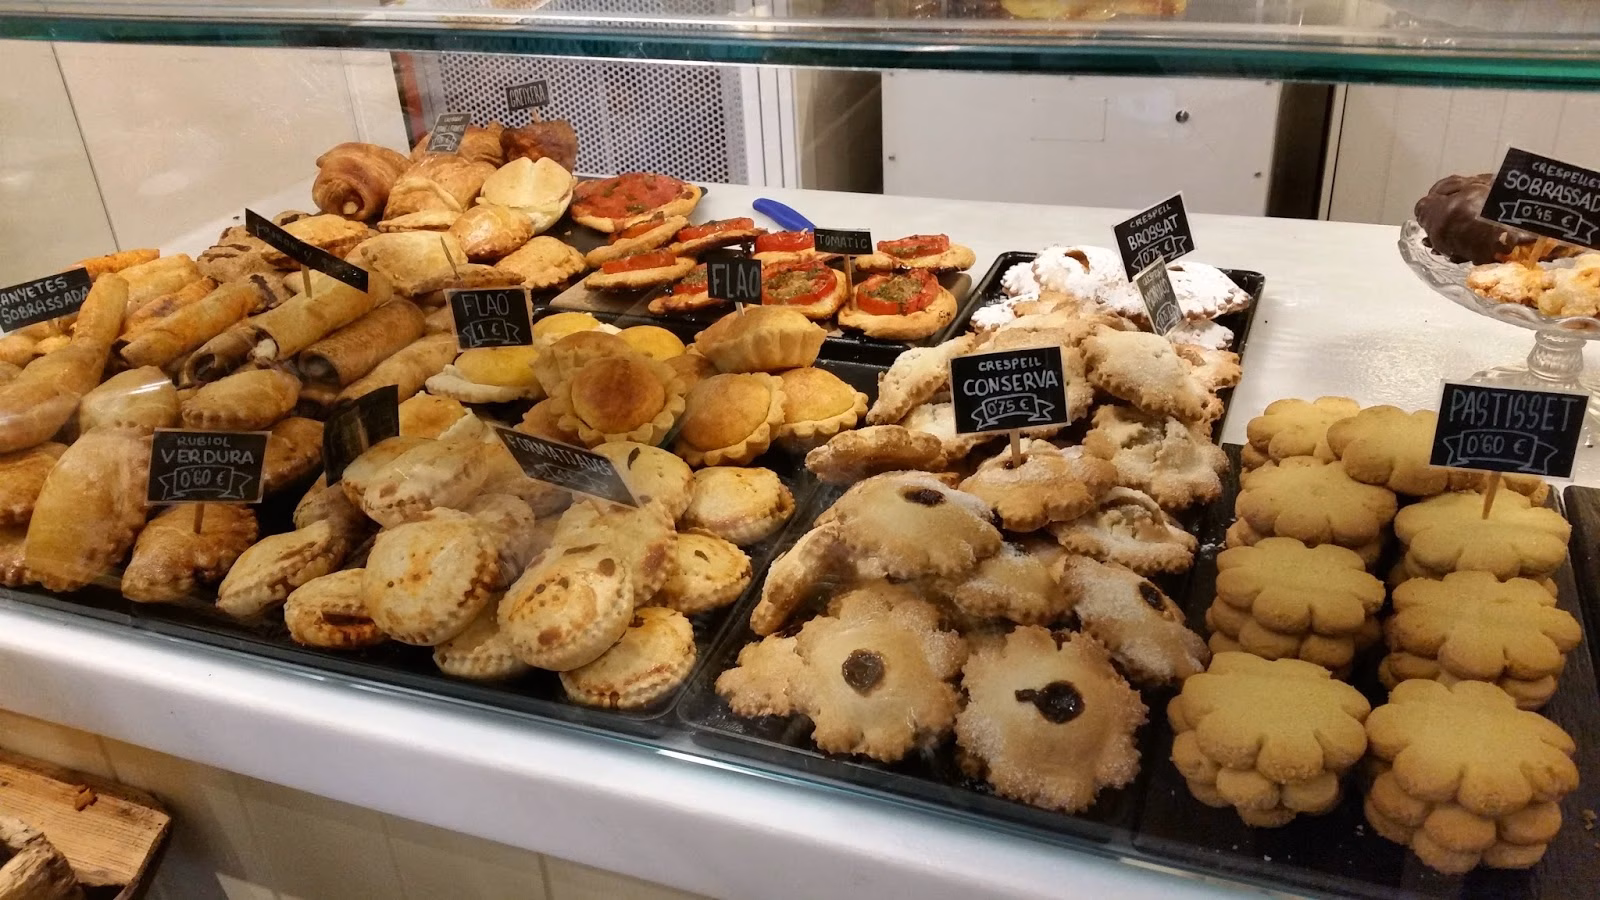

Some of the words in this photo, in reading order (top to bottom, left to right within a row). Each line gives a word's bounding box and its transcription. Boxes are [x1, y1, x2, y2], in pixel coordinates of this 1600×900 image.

[1129, 203, 1172, 228] CRESPELL
[1561, 215, 1574, 228] €
[1127, 213, 1179, 251] BROSSAT
[1164, 240, 1171, 252] €
[0, 276, 68, 306] ANYETES
[1, 286, 88, 324] SOBRASSADA
[461, 290, 510, 317] FLAÓ
[491, 323, 501, 336] €
[978, 357, 1042, 371] CRESPELL
[963, 369, 1058, 396] CONSERVA
[987, 399, 1016, 415] 0'75
[1020, 399, 1029, 410] €
[1449, 388, 1579, 432] PASTISSET
[177, 436, 231, 447] RUBIOL
[1466, 434, 1505, 454] 0'60
[1513, 439, 1528, 455] €
[161, 448, 254, 465] VERDURA
[504, 433, 613, 476] FORMATJADES
[180, 468, 211, 488] 0'60
[217, 471, 227, 486] €
